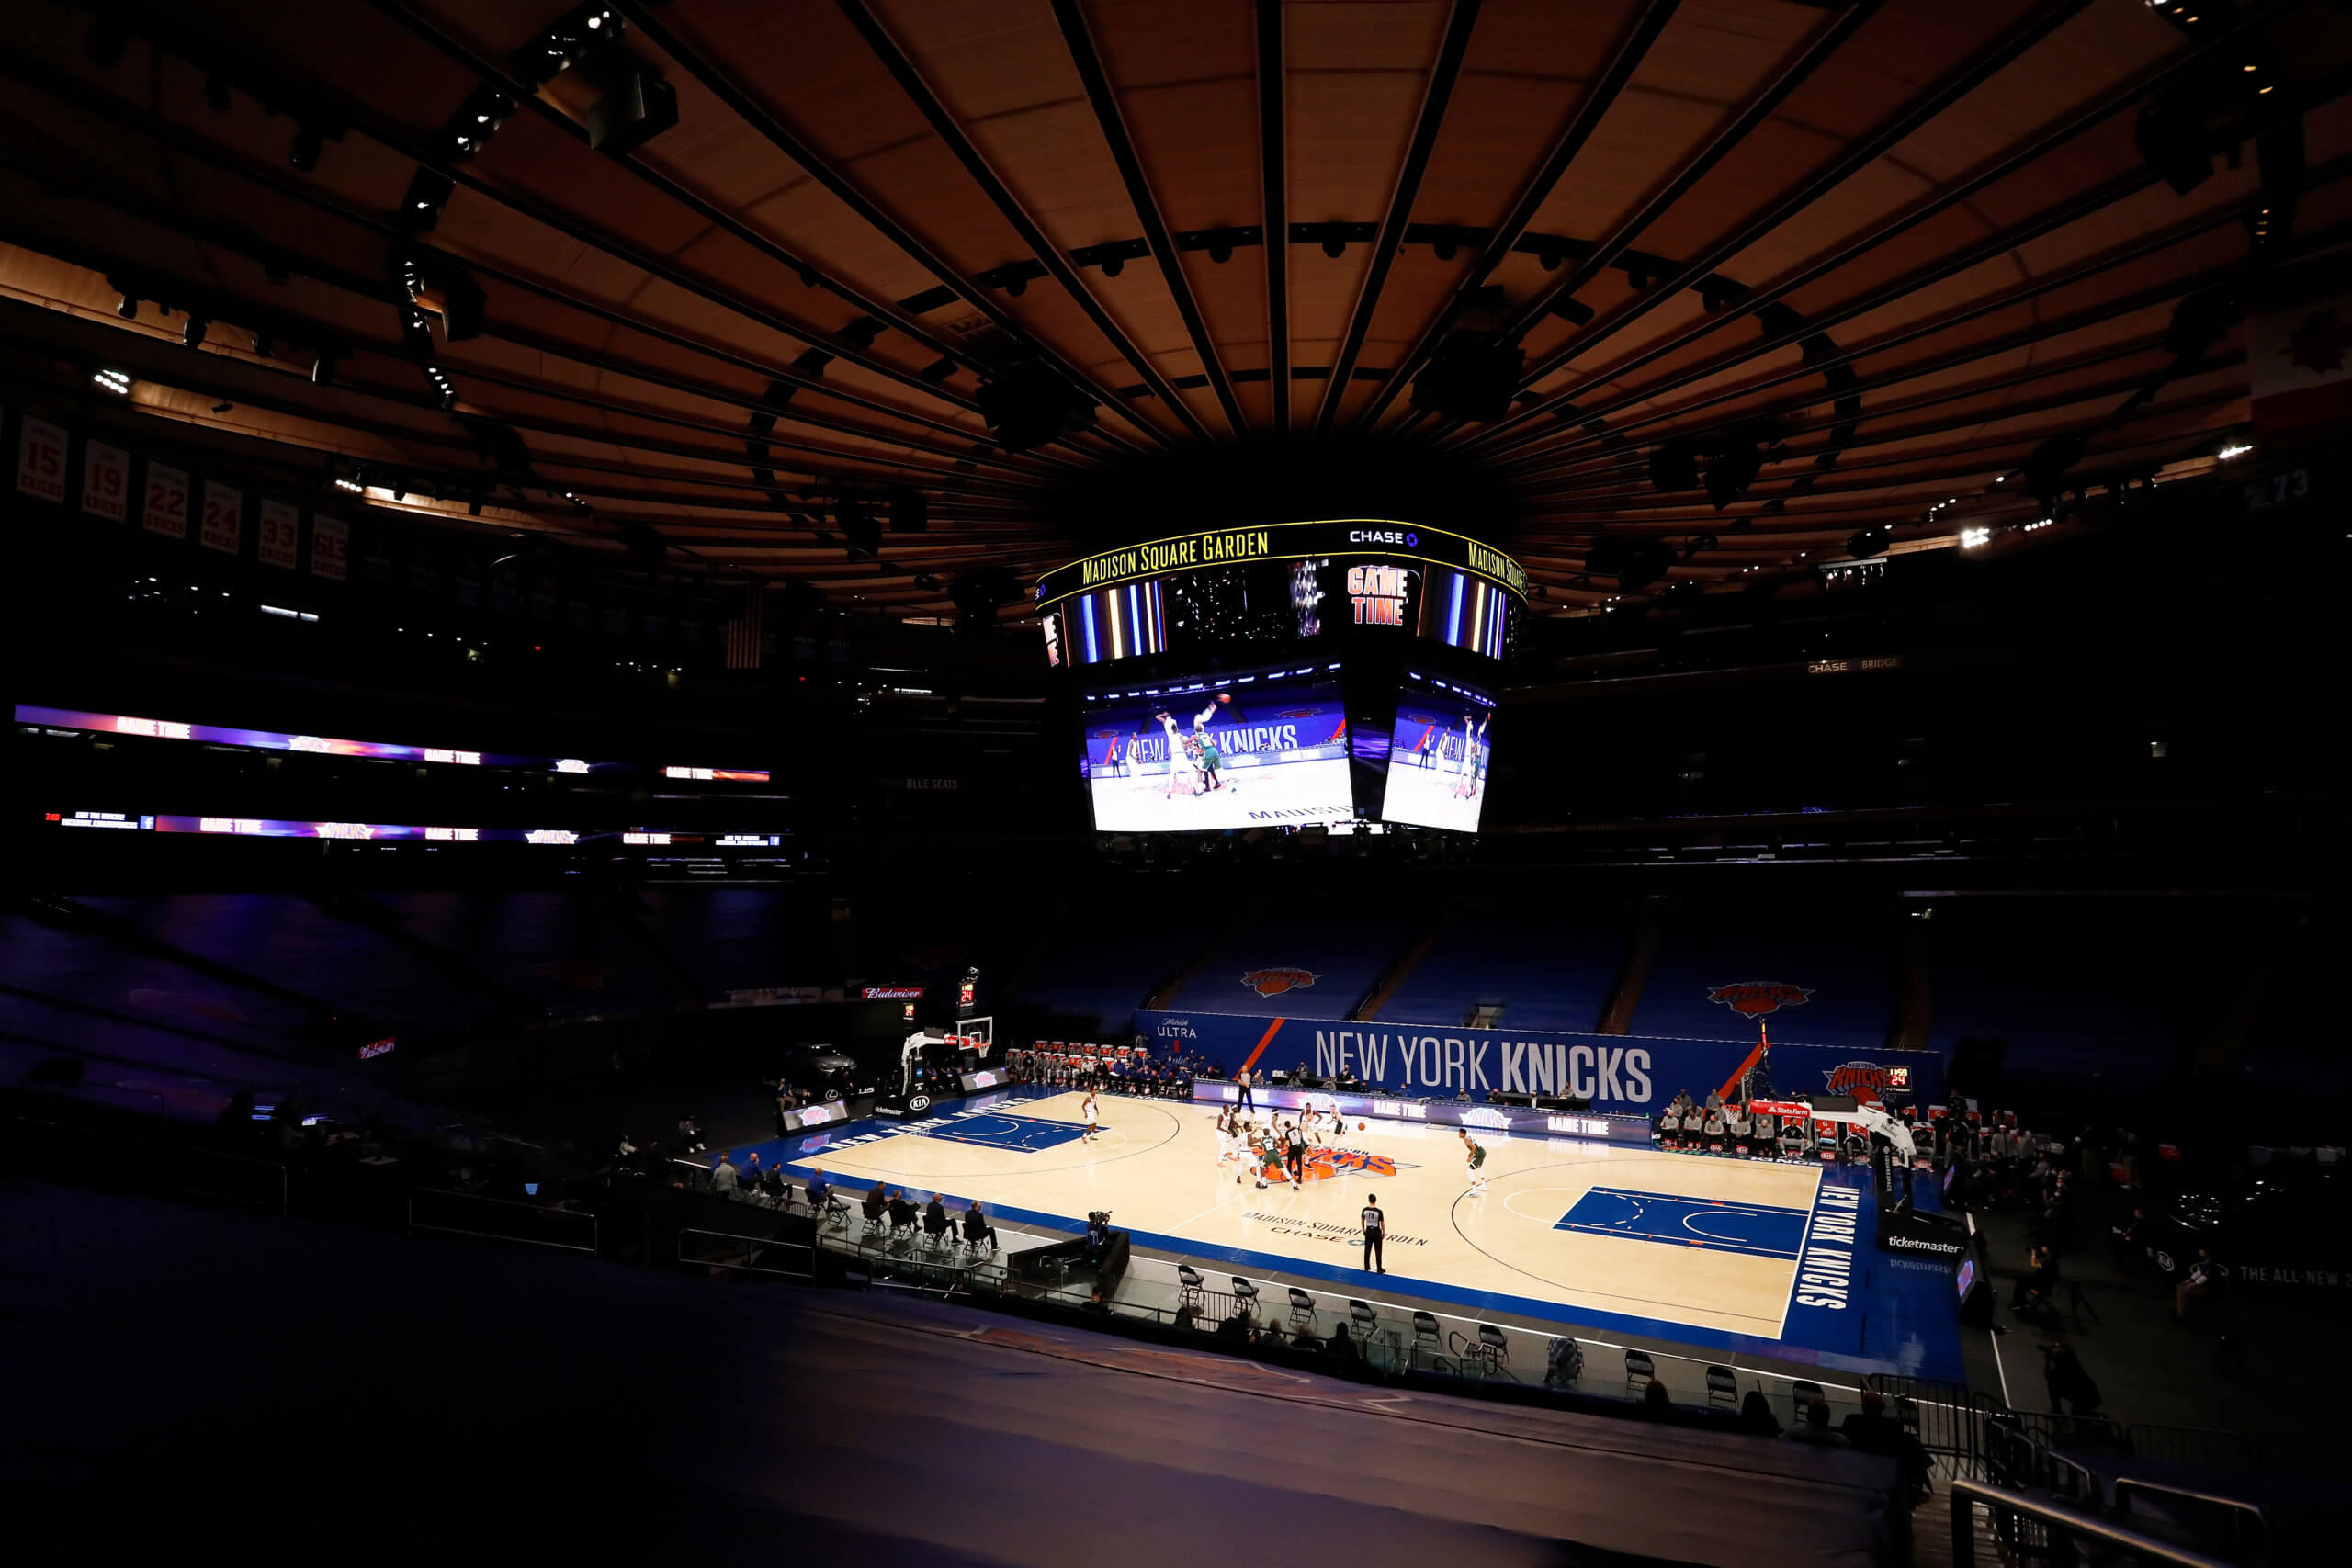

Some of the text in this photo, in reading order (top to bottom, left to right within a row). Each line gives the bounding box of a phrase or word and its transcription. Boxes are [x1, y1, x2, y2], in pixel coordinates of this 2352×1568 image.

[28, 442, 60, 476] 15
[94, 464, 121, 496] 19
[150, 483, 185, 516] 22
[205, 502, 236, 534] 24
[264, 519, 295, 547] 33
[315, 534, 345, 559] 613
[1350, 531, 1403, 544] CHASE
[1083, 532, 1268, 585] MADISON SQUARE GARDEN
[1469, 542, 1506, 579] MADISON
[1348, 566, 1408, 596] GAME
[1351, 597, 1403, 626] TIME
[1808, 658, 1897, 673] CHASE BRIDGE
[1219, 724, 1297, 755] KNICKS
[907, 778, 959, 791] BLUE SEATS
[866, 988, 920, 998] Budweiser
[961, 991, 971, 1001] 24
[1158, 1026, 1197, 1038] ULTRA
[1316, 1031, 1652, 1102] NEW YORK KNICKS
[1830, 1066, 1883, 1088] KNICK
[1892, 1076, 1905, 1085] 24
[820, 1098, 1035, 1149] NEW YORK KNICKS
[875, 1106, 904, 1116] ticketmaster
[1242, 1212, 1428, 1247] MADISON SQUARE RDEN
[1271, 1227, 1346, 1243] CHASE
[1796, 1185, 1860, 1310] NEW YORK KNICKS
[1889, 1235, 1960, 1254] ticketmaster
[2239, 1266, 2268, 1282] THE
[2273, 1268, 2338, 1286] ALL-NEW
